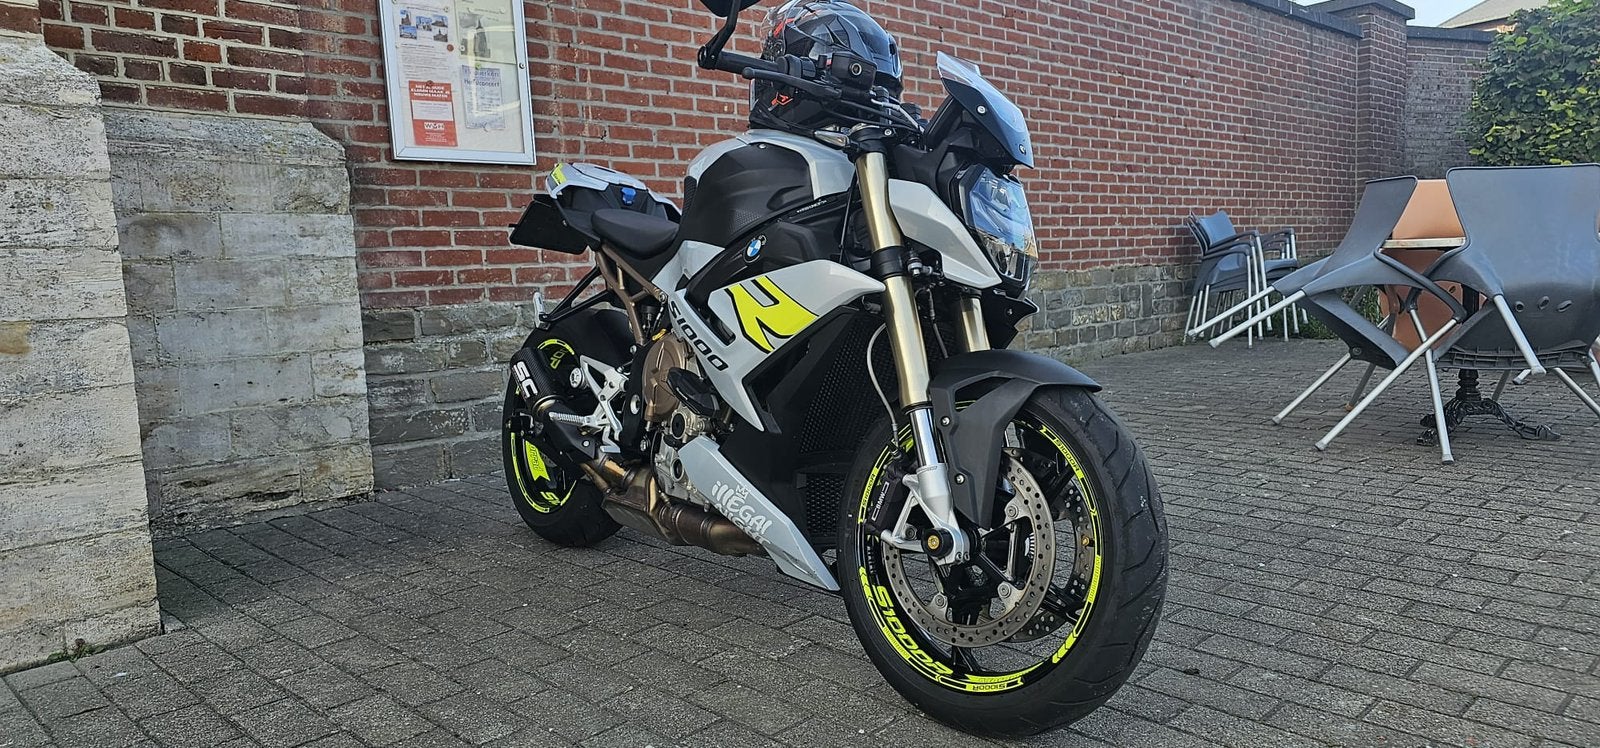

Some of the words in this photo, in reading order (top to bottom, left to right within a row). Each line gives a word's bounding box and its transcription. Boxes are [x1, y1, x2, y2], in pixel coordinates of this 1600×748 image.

[670, 300, 729, 372] S1000
[513, 361, 538, 399] SC
[1054, 439, 1080, 471] S1000R
[872, 584, 953, 677] S1000R
[972, 683, 1006, 691] S1000R
